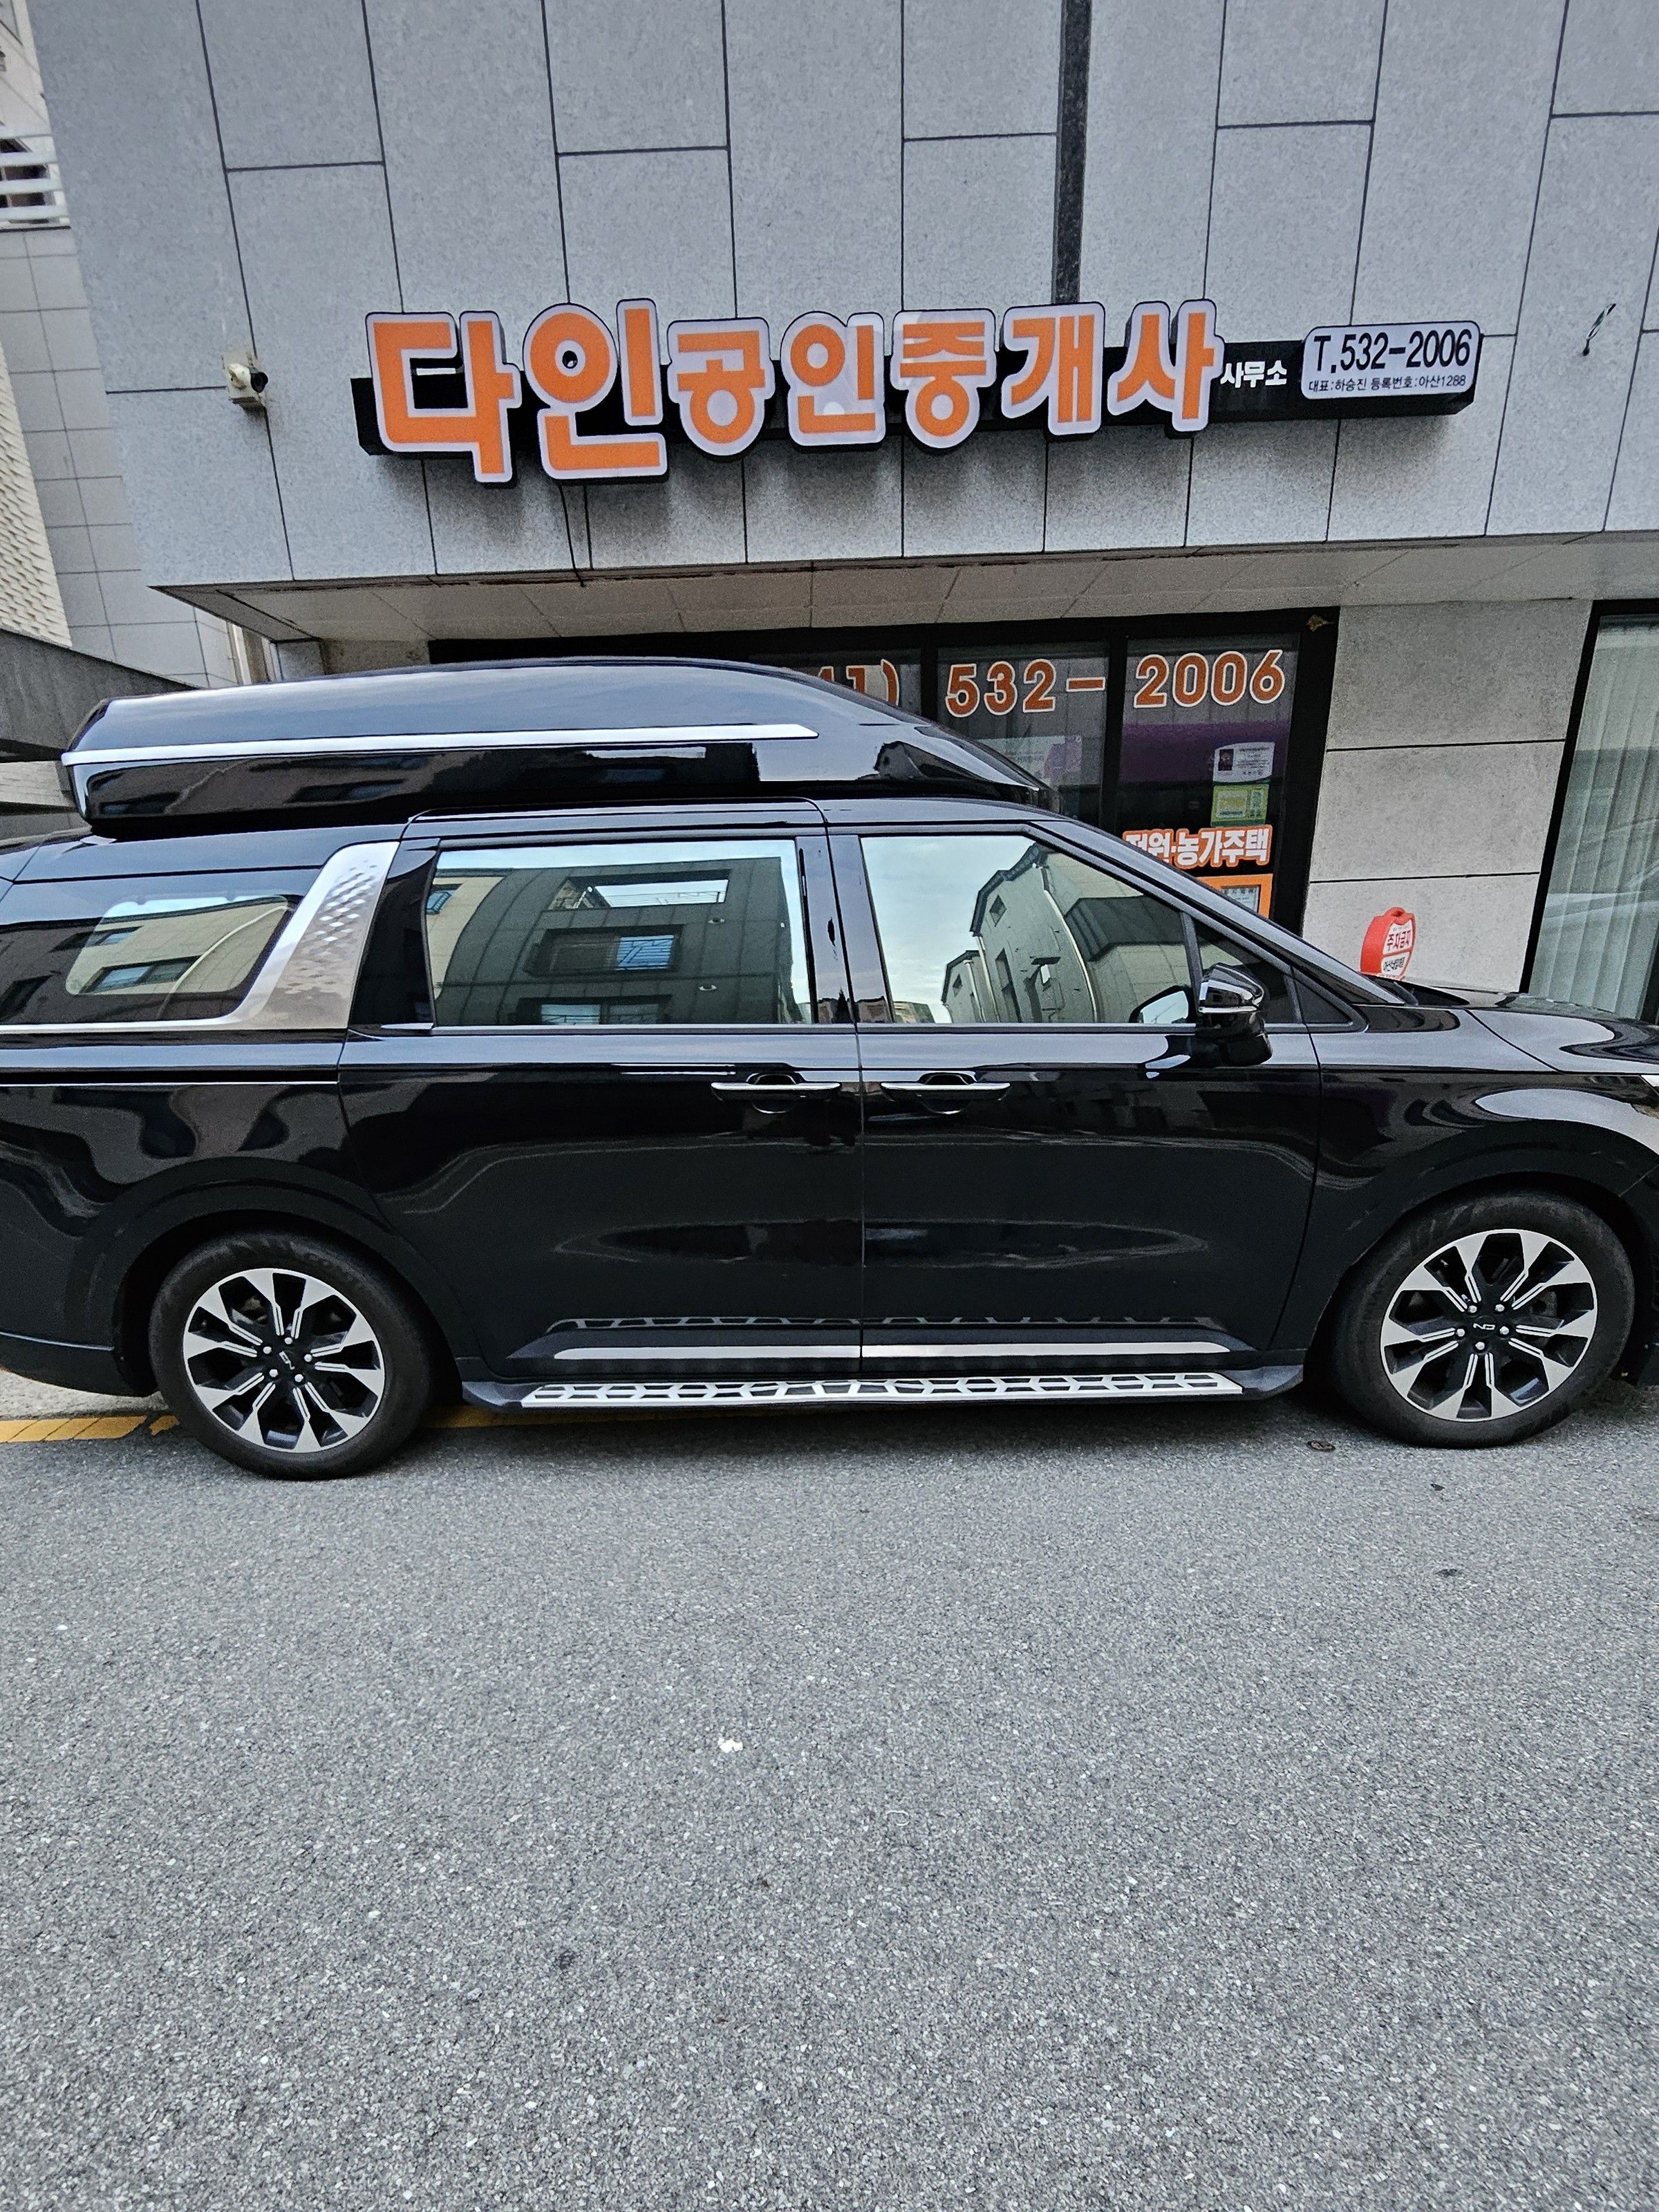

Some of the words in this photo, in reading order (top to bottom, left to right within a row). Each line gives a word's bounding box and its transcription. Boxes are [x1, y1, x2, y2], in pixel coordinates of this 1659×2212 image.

[1313, 329, 1472, 374] T.532-2006
[1221, 360, 1286, 388] 사무소
[1387, 930, 1412, 951] 주차금지
